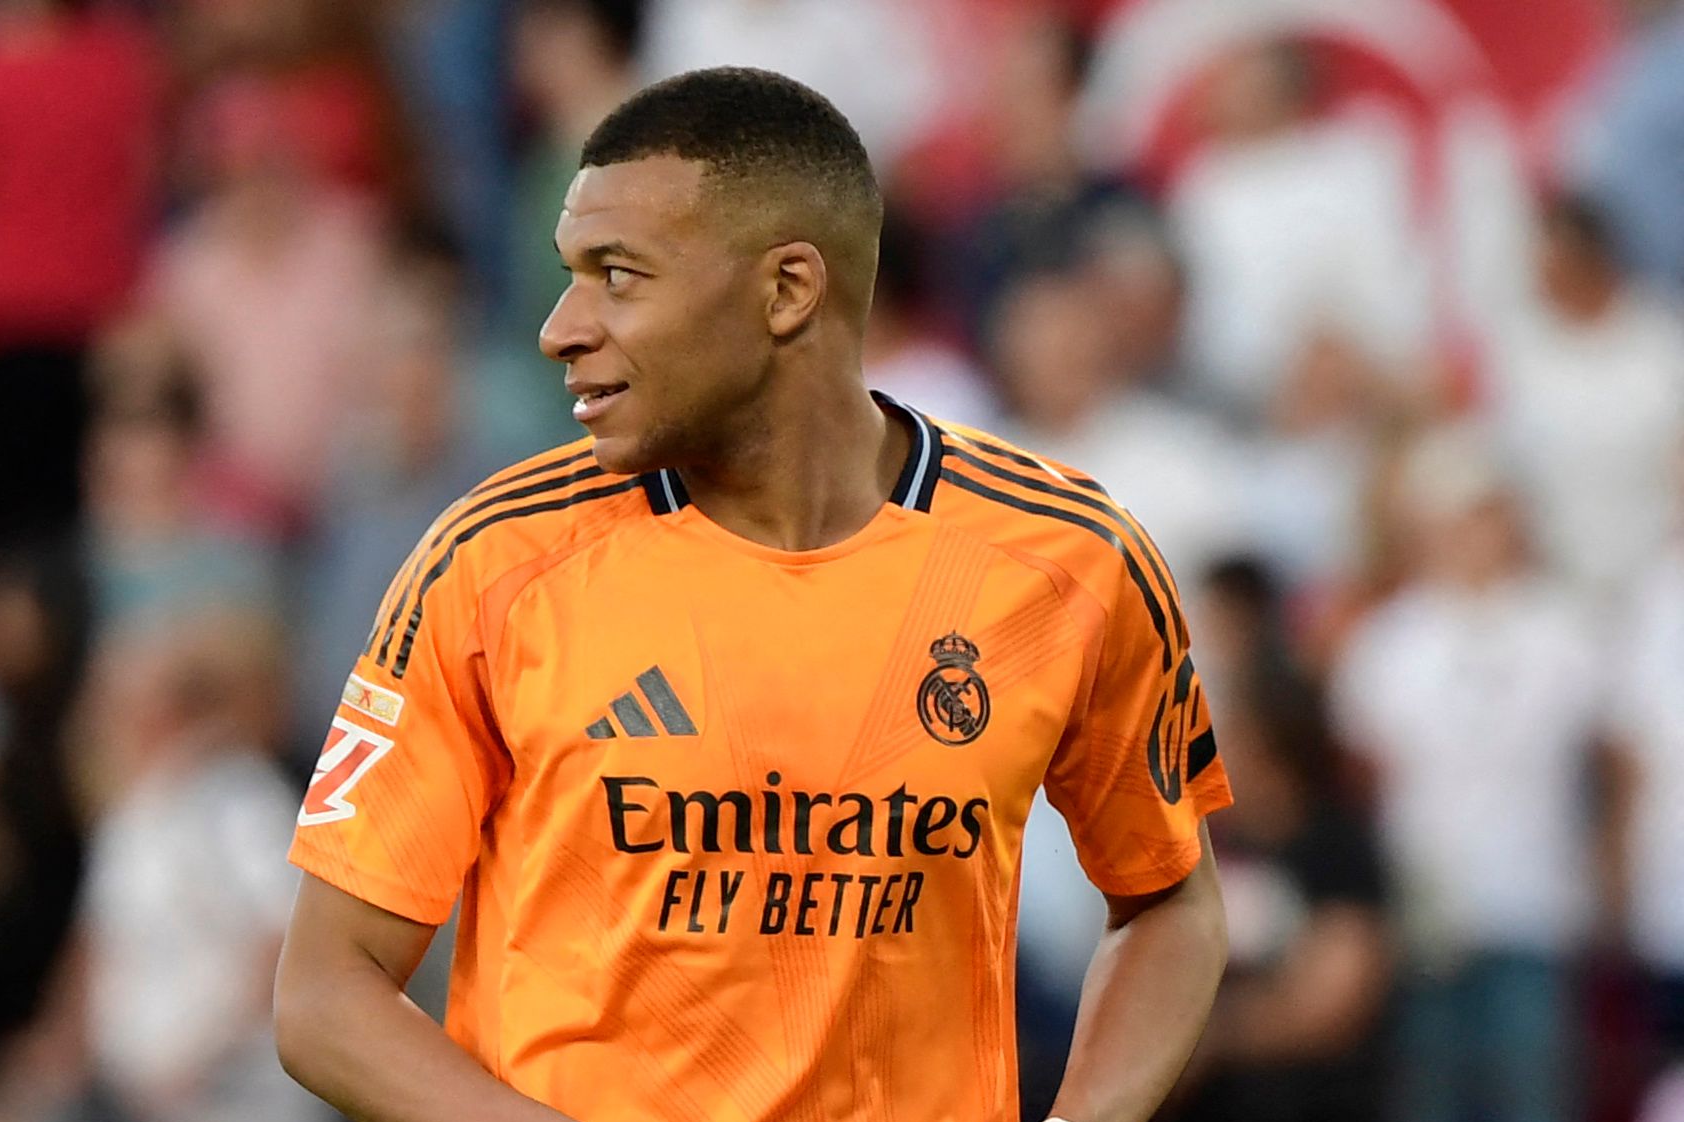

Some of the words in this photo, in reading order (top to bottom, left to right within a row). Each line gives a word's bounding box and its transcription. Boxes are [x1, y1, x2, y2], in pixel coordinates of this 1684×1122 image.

[601, 770, 989, 859] Emirates
[658, 869, 745, 933] FLY
[760, 870, 925, 939] BETTER
